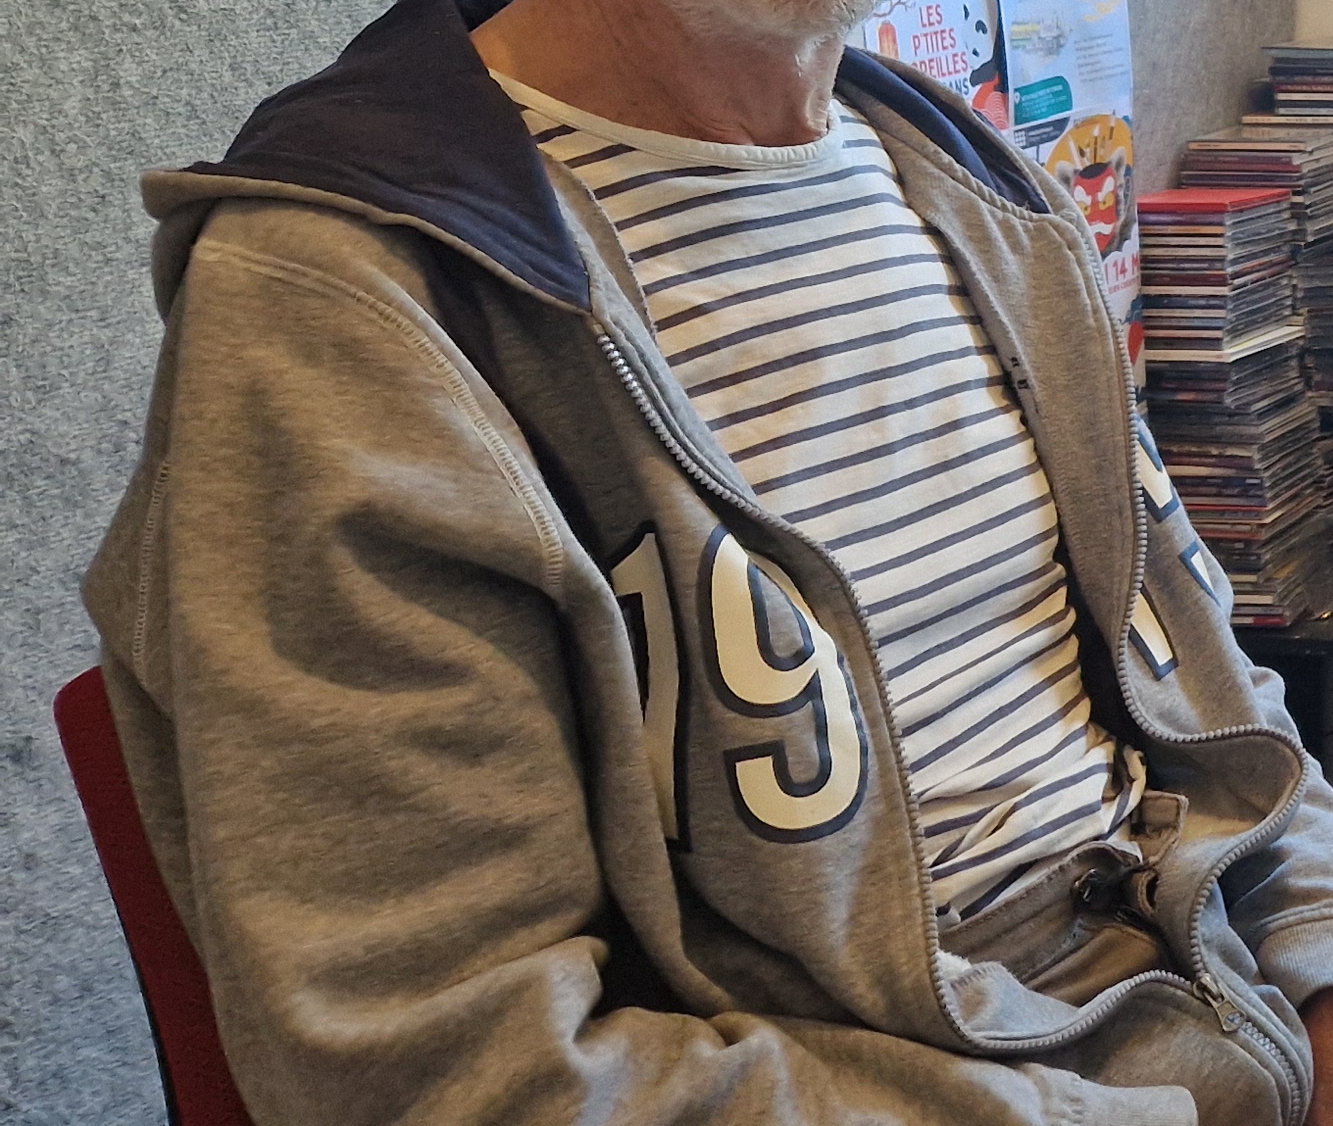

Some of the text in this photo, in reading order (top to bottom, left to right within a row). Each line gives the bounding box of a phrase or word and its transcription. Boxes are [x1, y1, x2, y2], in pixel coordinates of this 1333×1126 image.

[919, 4, 943, 28] LES
[912, 28, 957, 56] P'TITES
[1112, 256, 1128, 281] 14
[606, 522, 868, 852] 19
